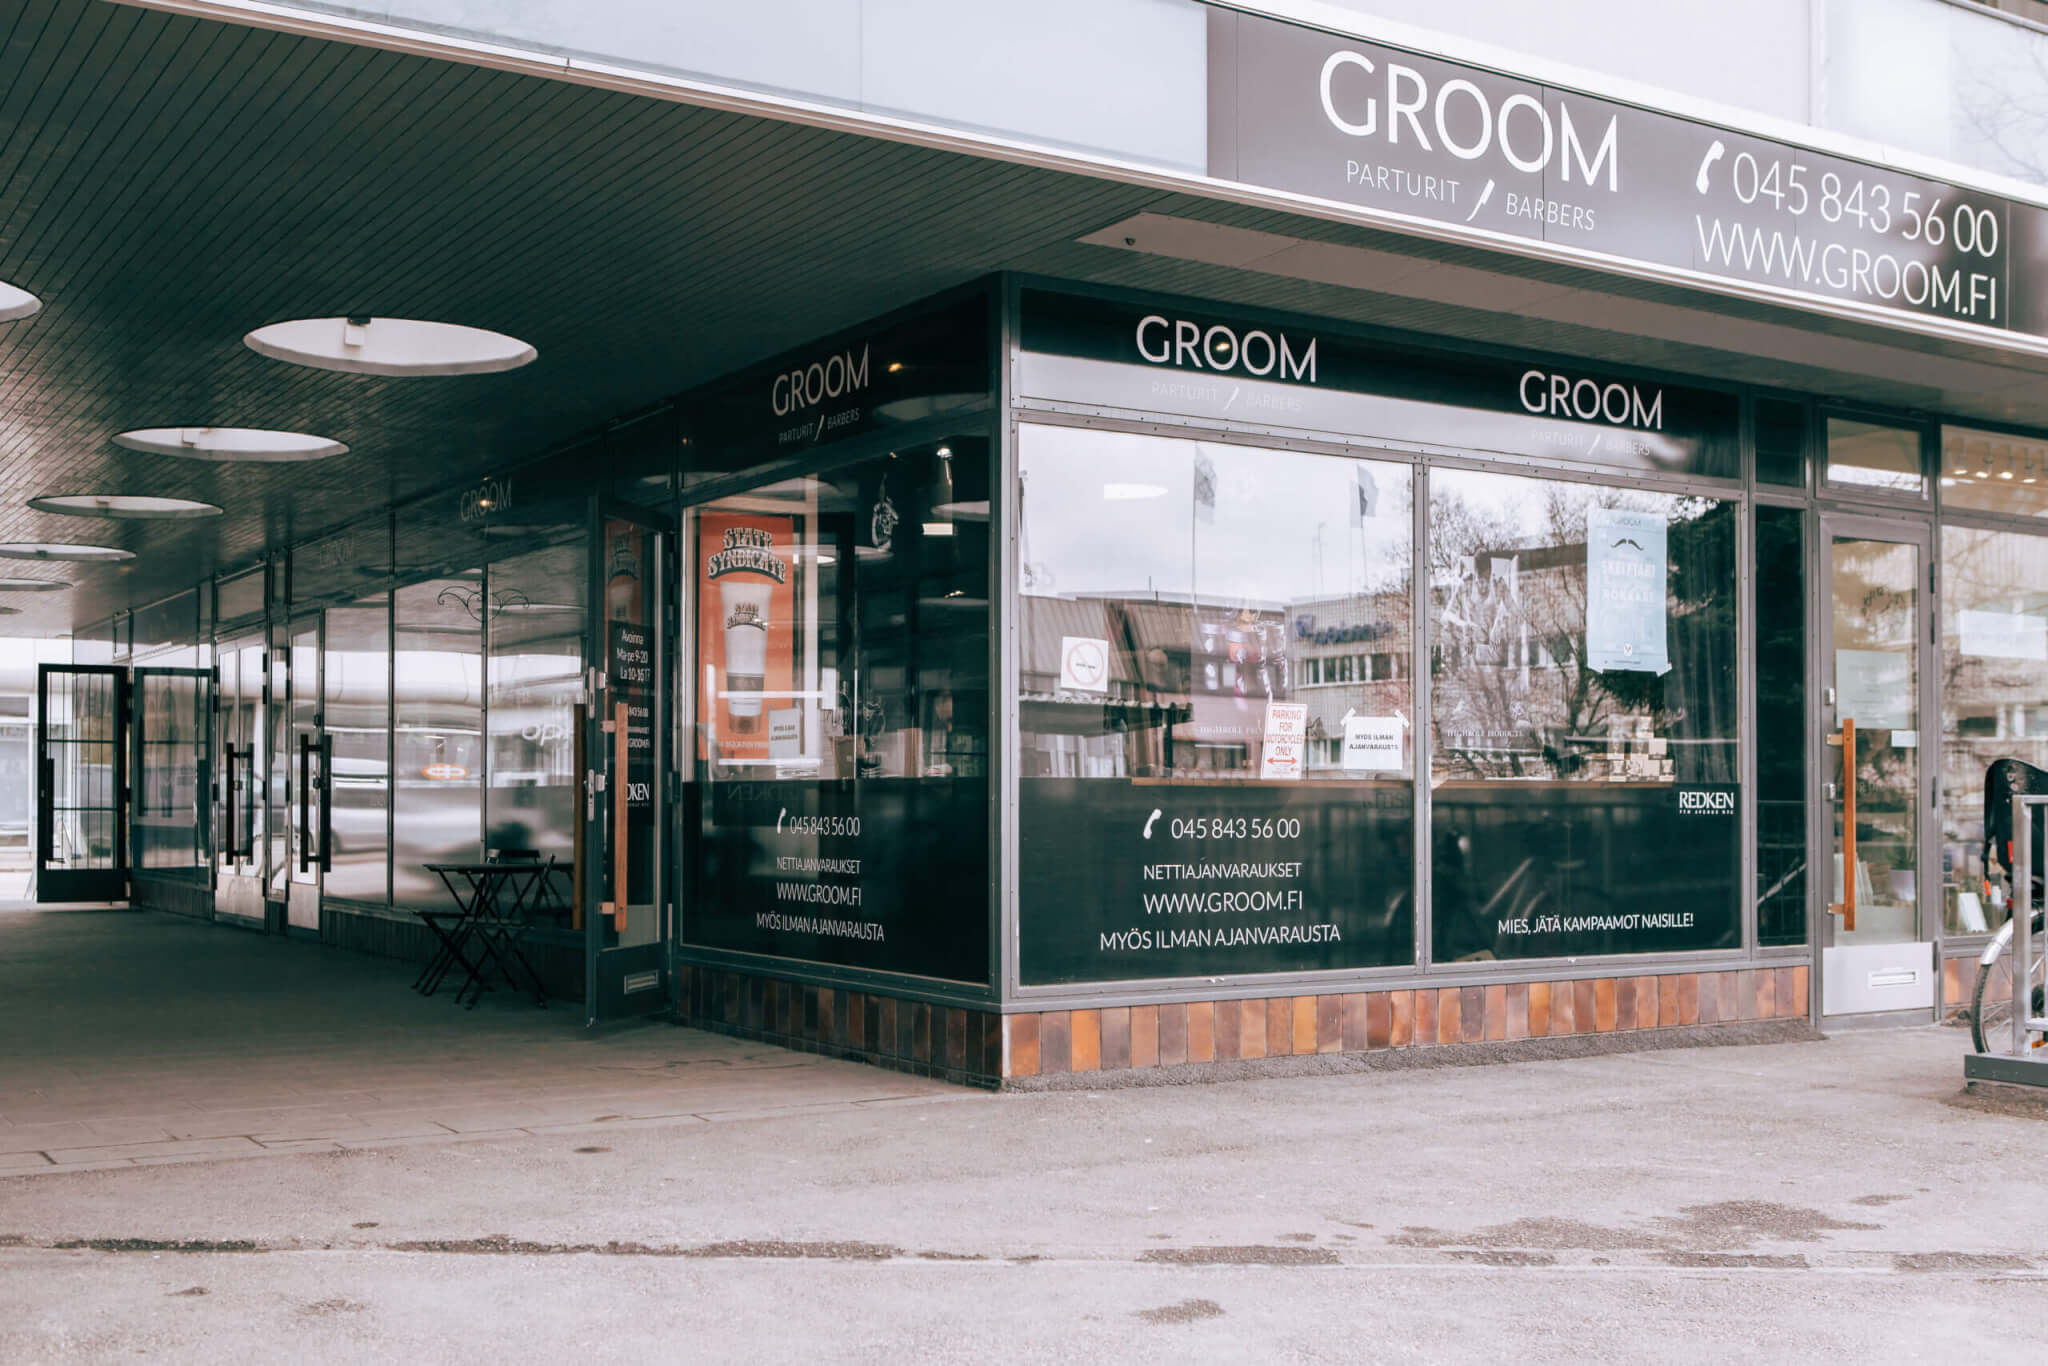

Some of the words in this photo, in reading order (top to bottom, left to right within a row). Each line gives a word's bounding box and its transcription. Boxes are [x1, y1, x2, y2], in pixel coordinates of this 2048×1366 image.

[1320, 51, 1617, 192] GROOM
[1347, 160, 1460, 203] PARTURIT
[1506, 192, 1596, 231] BARBERS
[1733, 152, 1809, 216] 045
[1820, 173, 1891, 233] 843
[1902, 191, 1946, 246] 56
[1953, 204, 1998, 257] 00
[1696, 214, 1997, 320] WWW.GROOM.FI
[1136, 315, 1317, 383] GROOM
[772, 342, 869, 416] GROOM
[1519, 370, 1662, 430] GROOM
[460, 480, 512, 522] GROOM
[723, 527, 773, 551] STATE
[707, 548, 787, 584] SYNDICATE
[1271, 709, 1302, 720] PARKING
[1279, 721, 1294, 732] FOR
[1263, 733, 1305, 744] MOTORCYCLES
[1275, 745, 1293, 756] ONLY
[626, 784, 650, 801] DKEN
[1679, 791, 1735, 809] REDKEN
[789, 816, 809, 835] 045
[810, 816, 830, 836] 843
[831, 817, 845, 836] 56
[846, 817, 860, 837] 00
[1171, 818, 1207, 839] 045
[1211, 818, 1247, 839] 843
[1250, 818, 1274, 838] 56
[1276, 818, 1301, 838] 00
[776, 856, 862, 874] NETTIAJANVARAUKSET
[1143, 862, 1303, 880] NETTIAJANVARAUKSET
[776, 881, 862, 907] WWW.GROOM.FI
[1143, 890, 1304, 915] WWW.GROOM.FI
[756, 910, 781, 931] MYÖS
[782, 914, 811, 934] ILMAN
[811, 917, 885, 942] AJANVARAUSTA
[1498, 918, 1532, 936] MIES,
[1532, 914, 1562, 935] JÄTÄ
[1563, 914, 1640, 933] KAMPAAMOT
[1641, 912, 1695, 929] NAISILLE!
[1099, 927, 1152, 951] MYÖS
[1156, 928, 1212, 949] ILMAN
[1214, 924, 1342, 947] AJANVARAUSTA
